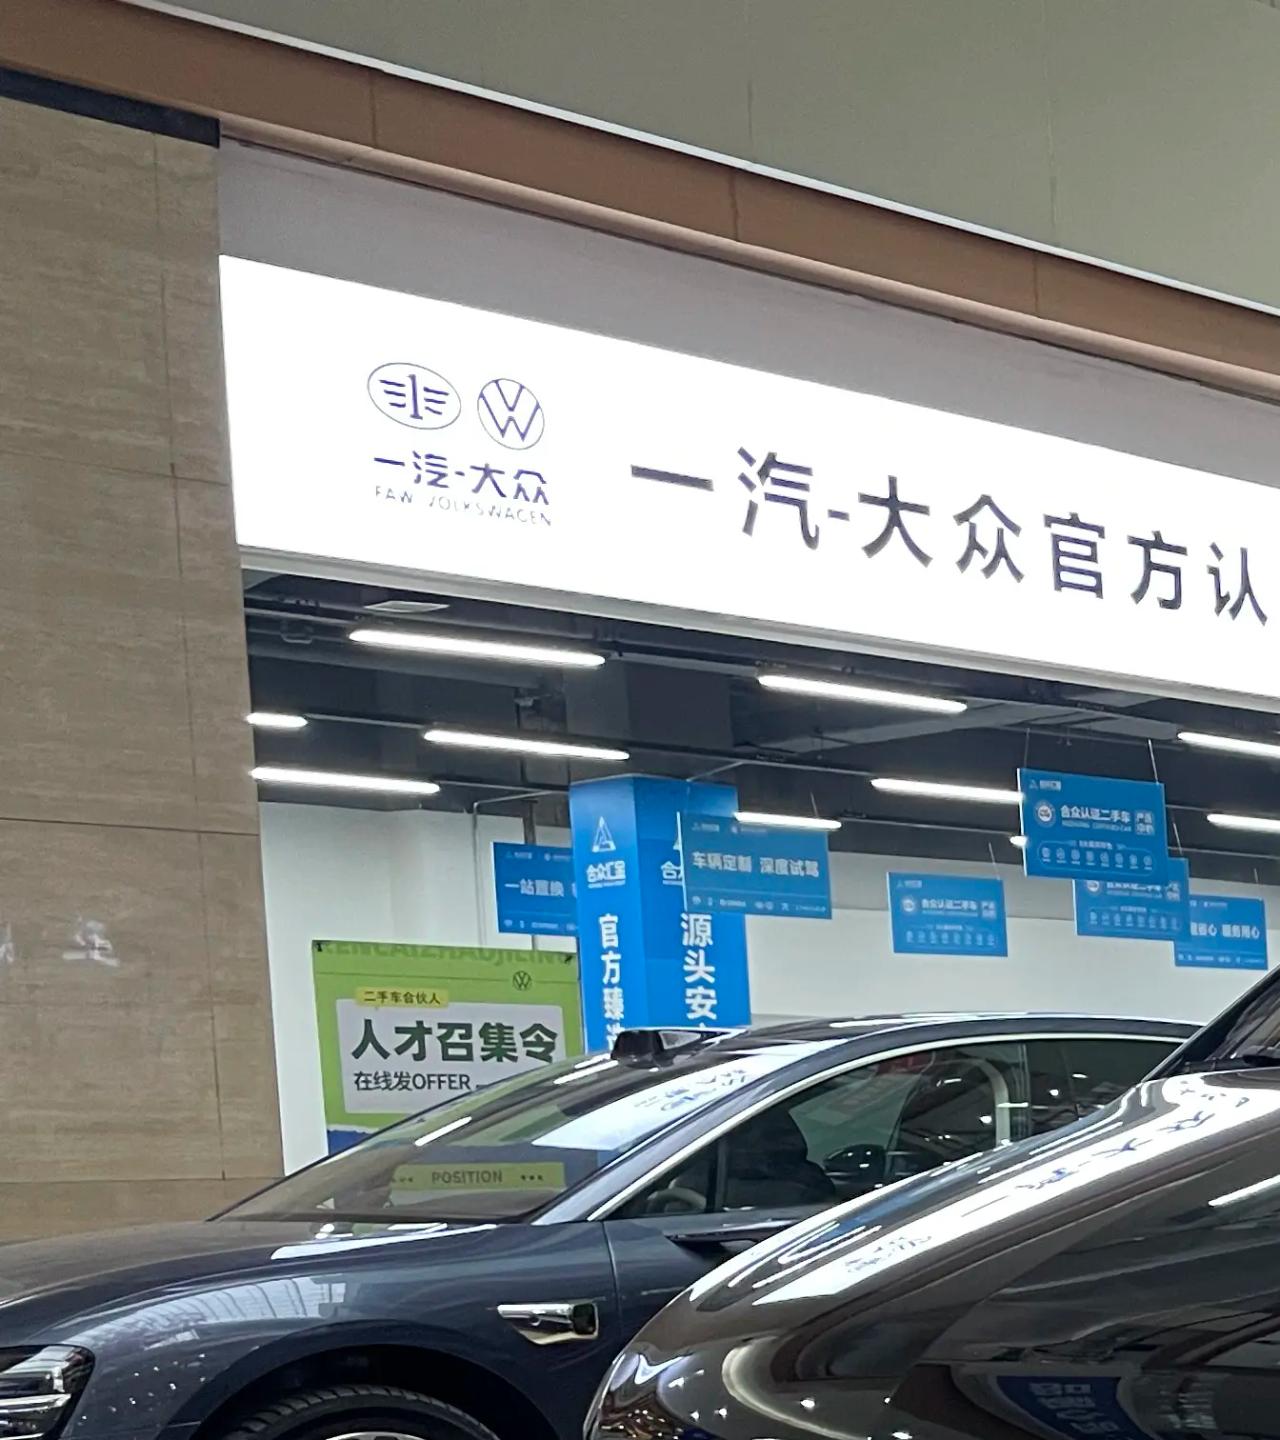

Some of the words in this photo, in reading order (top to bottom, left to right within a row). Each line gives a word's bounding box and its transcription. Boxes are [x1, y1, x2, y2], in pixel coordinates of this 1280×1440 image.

[374, 450, 550, 505] 一汽-大众
[363, 990, 441, 1006] 二手车合伙人
[351, 1018, 558, 1063] 人才召集令
[353, 1071, 471, 1091] 在线发OFFER
[431, 1169, 502, 1184] POSITION
